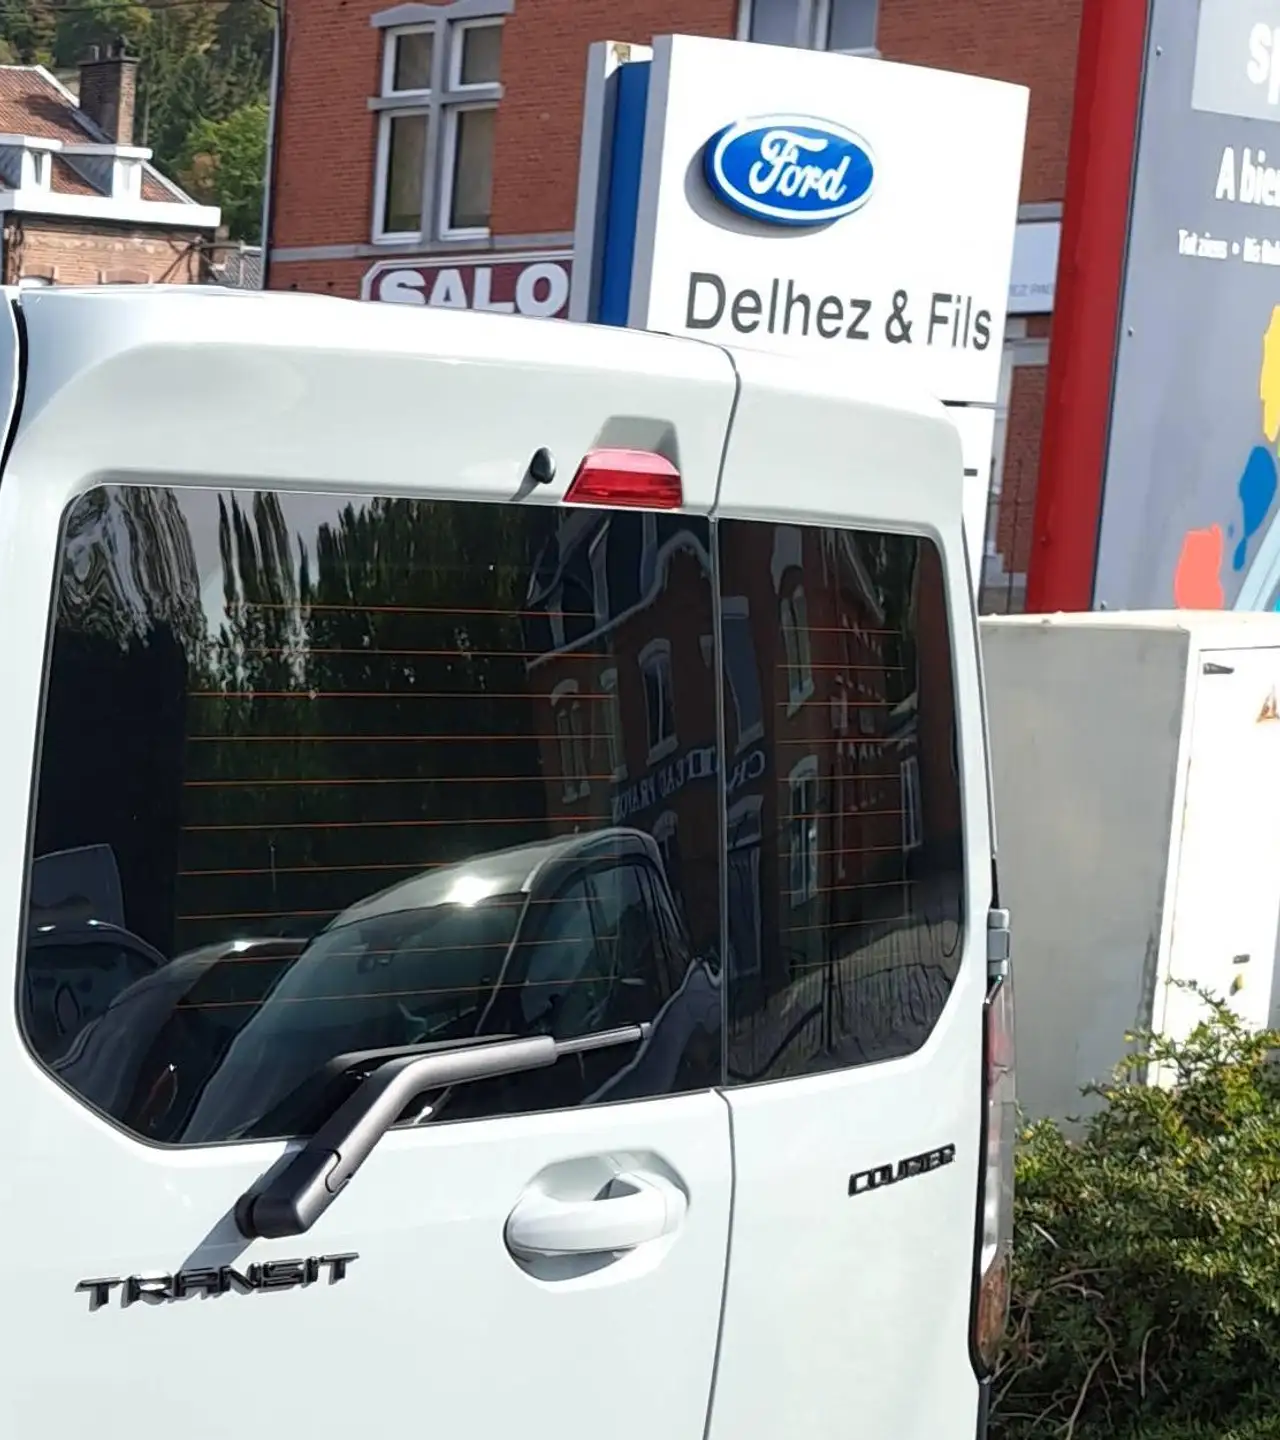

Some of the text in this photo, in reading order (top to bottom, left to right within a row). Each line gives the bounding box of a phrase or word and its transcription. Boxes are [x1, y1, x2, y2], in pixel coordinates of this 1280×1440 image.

[749, 130, 852, 202] Ford
[1215, 147, 1280, 208] A bie
[685, 271, 992, 351] Delhez & Fils
[74, 1251, 360, 1312] TRANSIT
